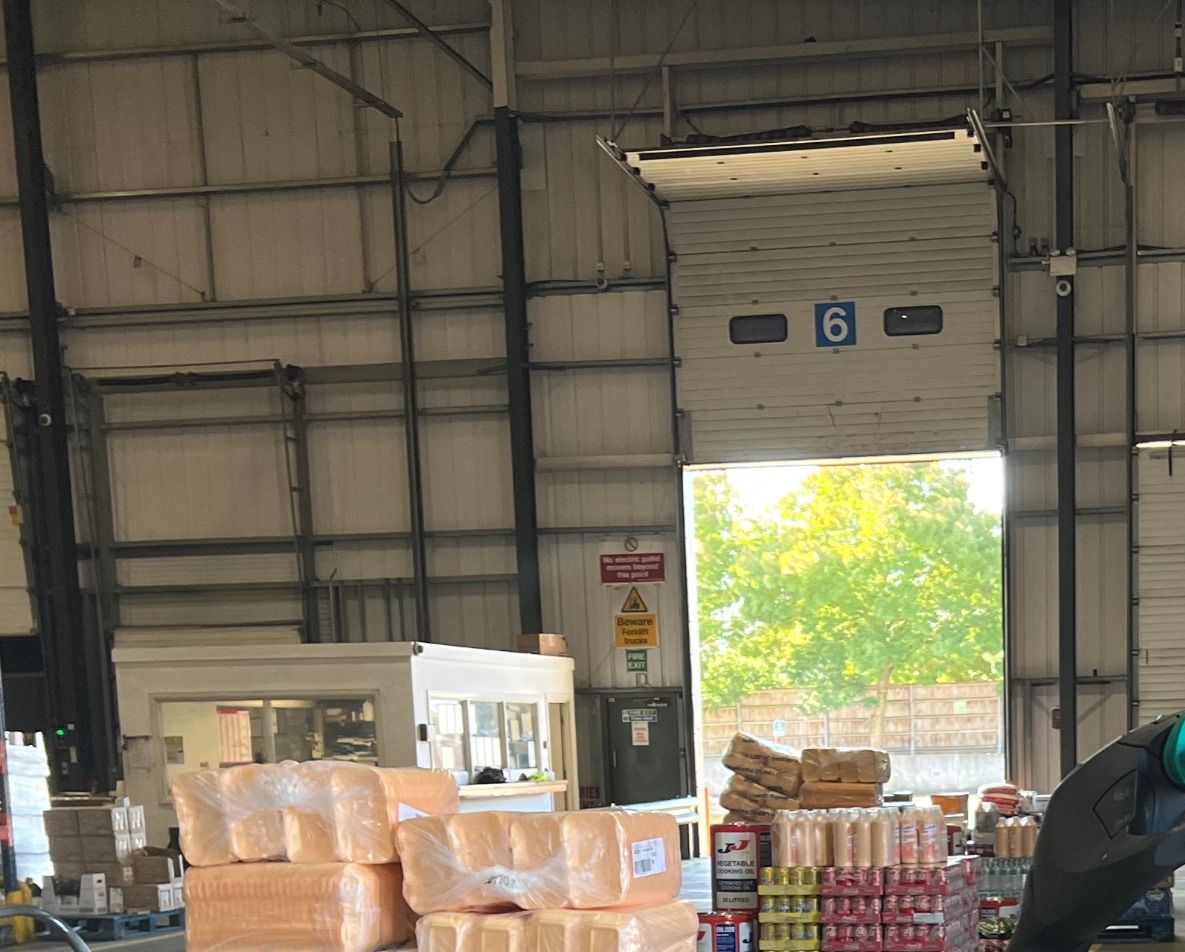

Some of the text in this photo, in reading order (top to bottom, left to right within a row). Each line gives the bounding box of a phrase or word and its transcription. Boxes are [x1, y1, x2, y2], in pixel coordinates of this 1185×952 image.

[823, 306, 849, 342] 6
[616, 617, 654, 626] Beware
[622, 627, 649, 635] Forklift
[623, 637, 648, 645] trucks
[627, 652, 646, 660] FIRE
[628, 661, 646, 669] EXIT
